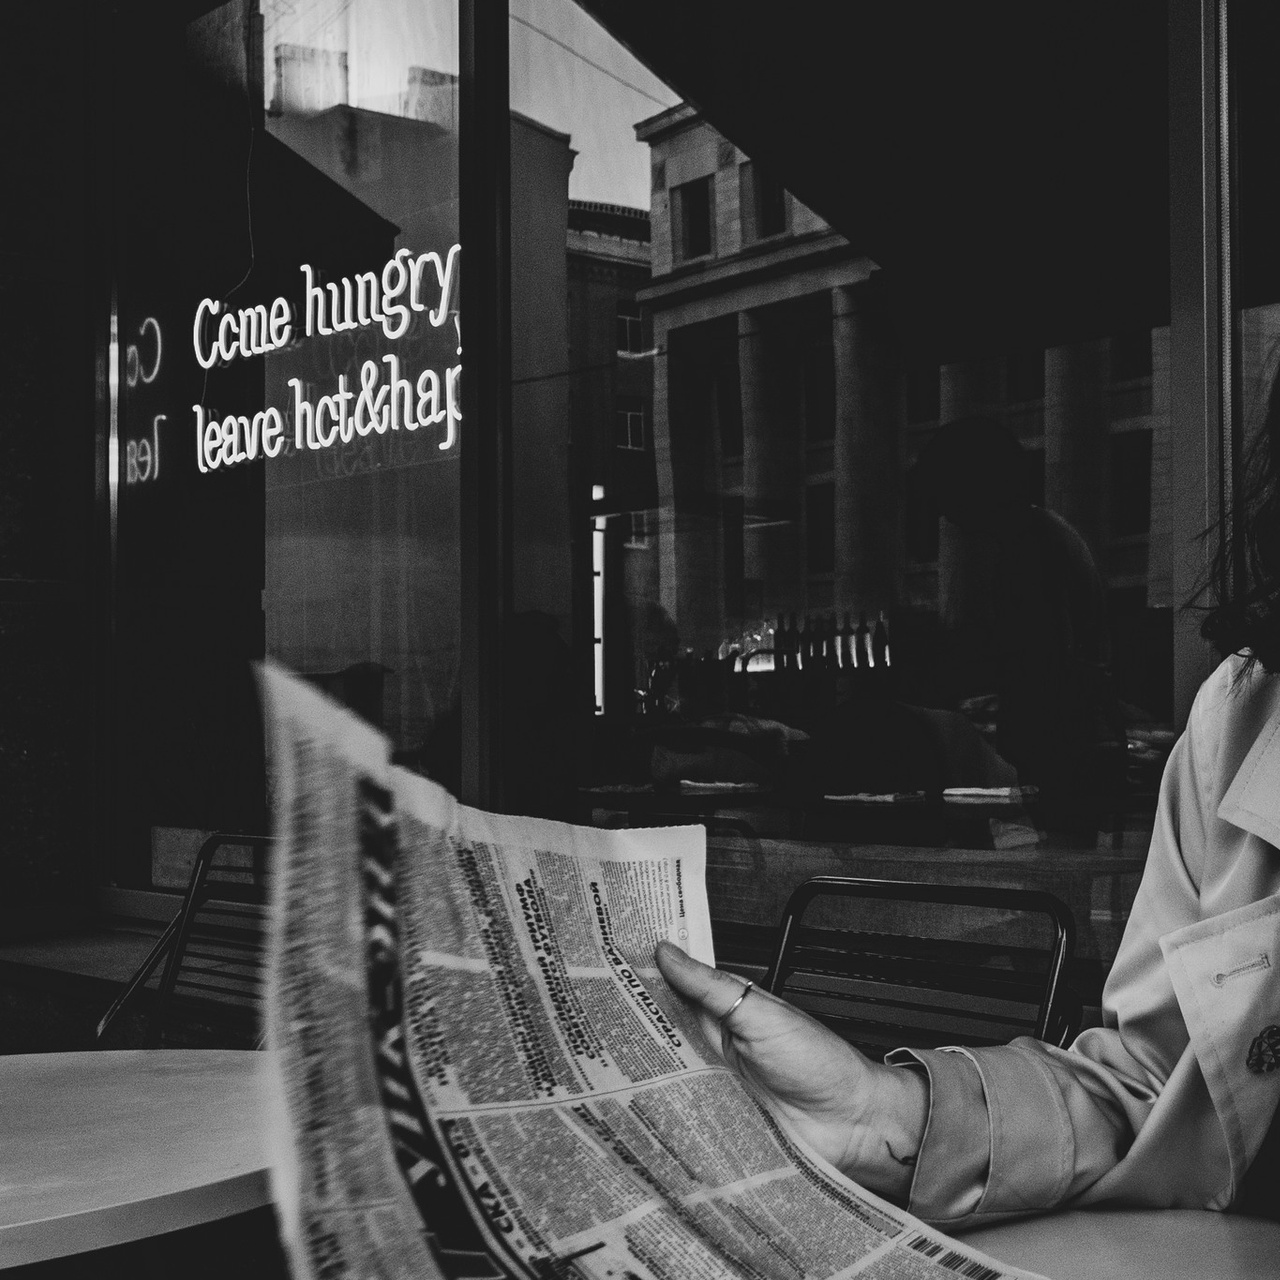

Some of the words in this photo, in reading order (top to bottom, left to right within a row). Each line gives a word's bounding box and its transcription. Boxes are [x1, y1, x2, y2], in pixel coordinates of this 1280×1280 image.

[301, 243, 463, 339] hungry
[193, 404, 285, 473] leave
[672, 858, 685, 898] свободная
[676, 898, 686, 918] Цена
[512, 881, 543, 951] ТРИУМФ
[521, 876, 554, 957] ФУТБОЛА
[588, 882, 623, 966] ВАЛИЕВОЙ
[535, 954, 583, 1056] ПОСЛЕДНИЙ
[546, 959, 596, 1060] СОВЕТСКОГО
[618, 966, 641, 990] ПО
[635, 987, 683, 1049] СТРАСТИ
